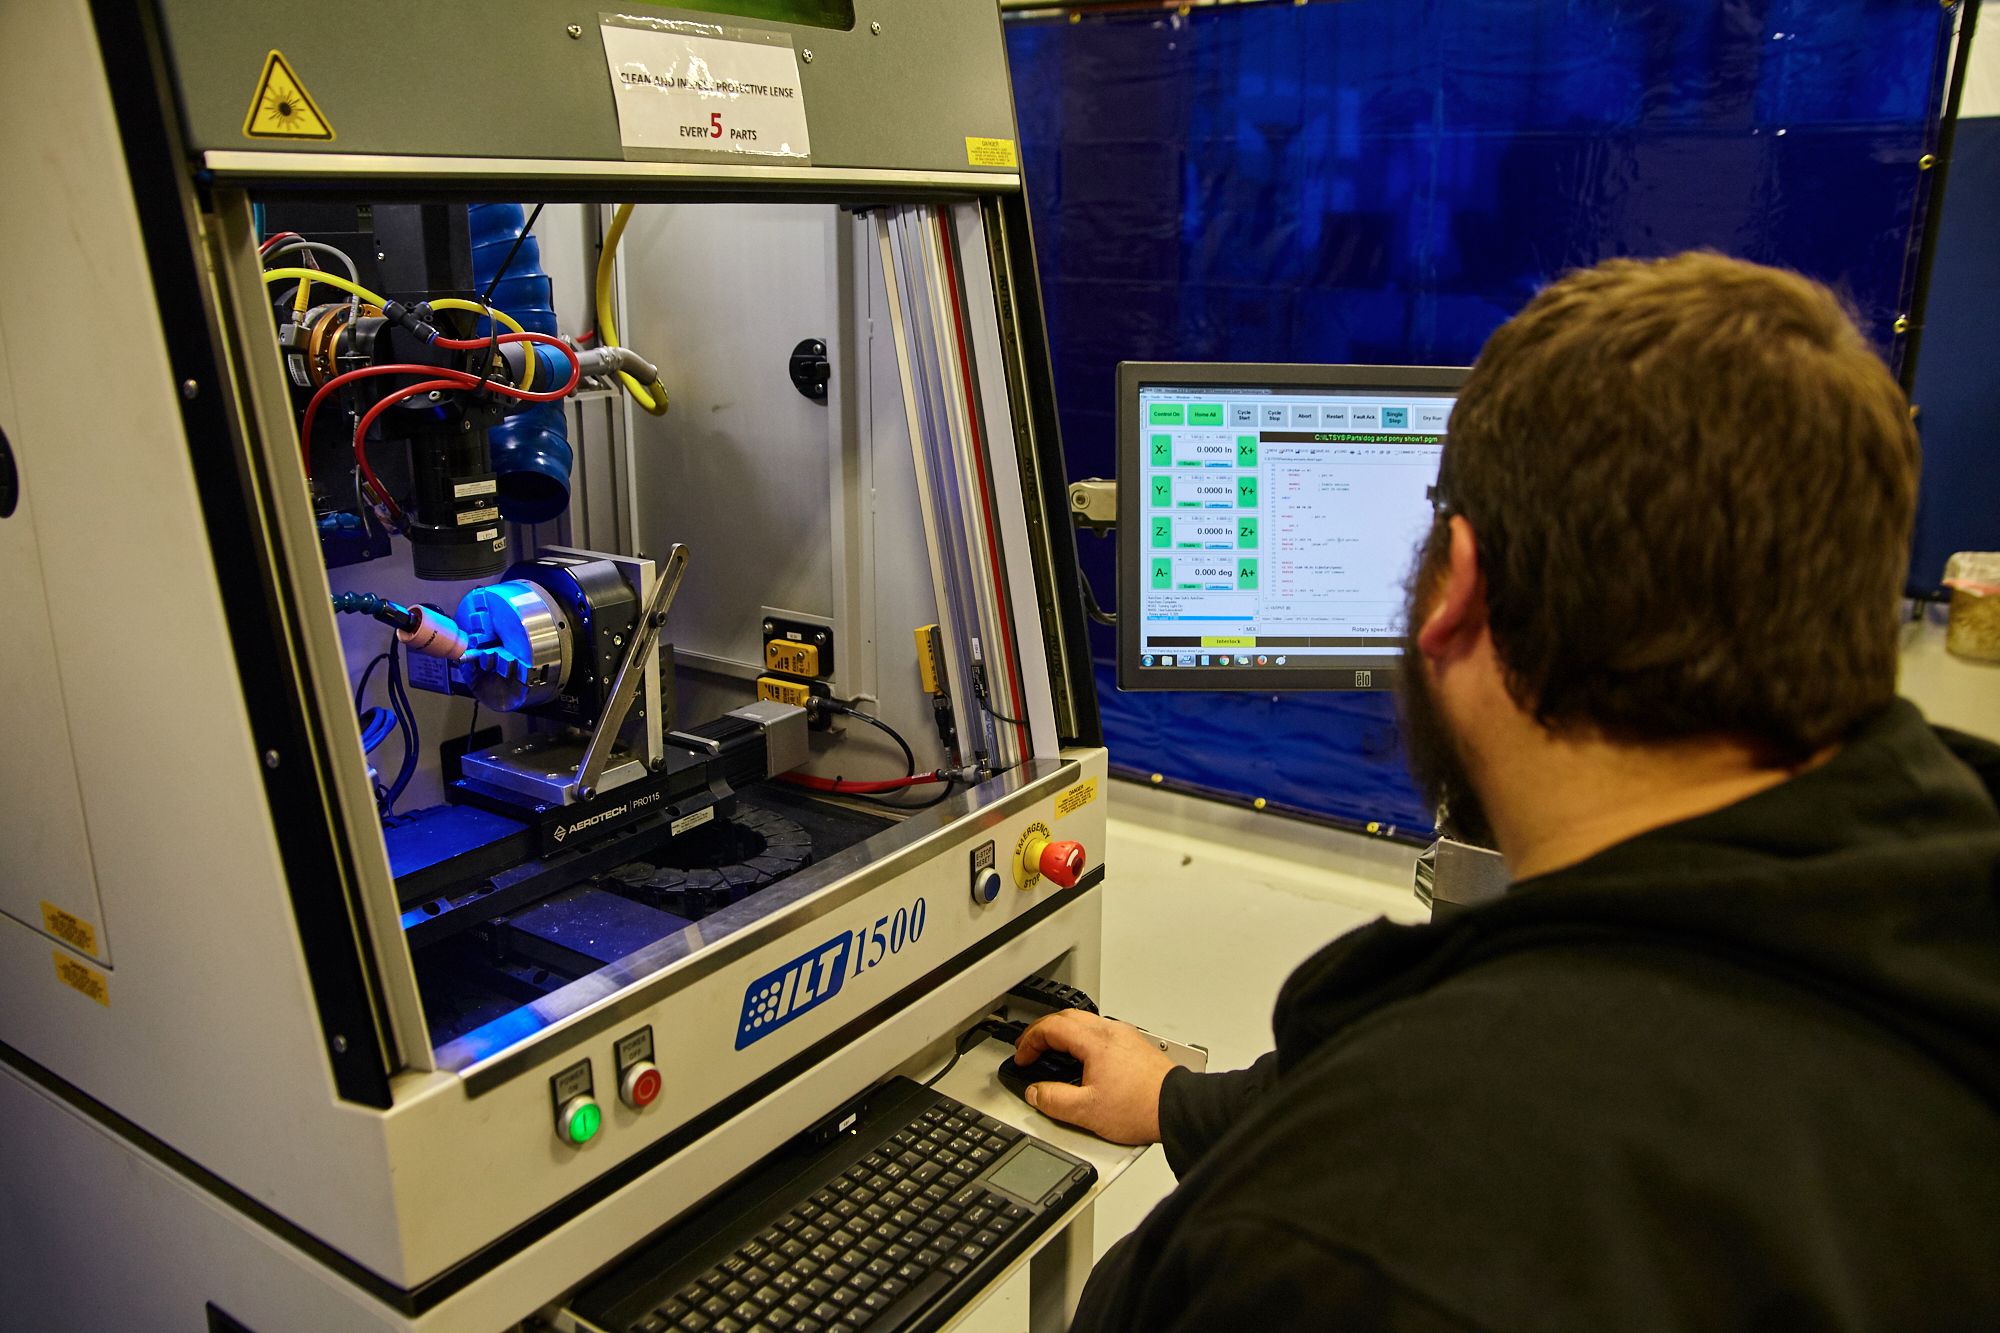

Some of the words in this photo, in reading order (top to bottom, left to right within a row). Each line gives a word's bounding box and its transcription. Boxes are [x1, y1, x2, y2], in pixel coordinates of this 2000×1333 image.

[620, 72, 650, 84] CLEAN
[653, 76, 674, 88] AND
[677, 79, 714, 92] INPECT
[716, 82, 767, 96] PROTECTIVE
[770, 86, 794, 98] LENSE
[680, 126, 708, 138] EVERY
[710, 113, 723, 139] 5
[730, 129, 757, 140] PARTS
[1155, 444, 1168, 454] X-
[1240, 446, 1255, 455] X+
[1155, 485, 1168, 495] Y-
[1240, 486, 1255, 496] Y+
[1155, 526, 1168, 536] Z-
[1240, 527, 1255, 537] Z+
[1155, 568, 1168, 577] A-
[1218, 569, 1232, 577] deg
[1240, 568, 1255, 577] A+
[568, 804, 627, 834] AEROTECH
[633, 792, 660, 809] PRO115
[1016, 822, 1050, 856] EMERGENCY
[976, 846, 992, 860] E-STOP
[976, 855, 991, 867] RESET
[1023, 872, 1041, 888] STOP
[776, 942, 844, 1021] ILT
[851, 897, 926, 979] 1500
[622, 1034, 646, 1052] POWER
[629, 1048, 641, 1060] OFF
